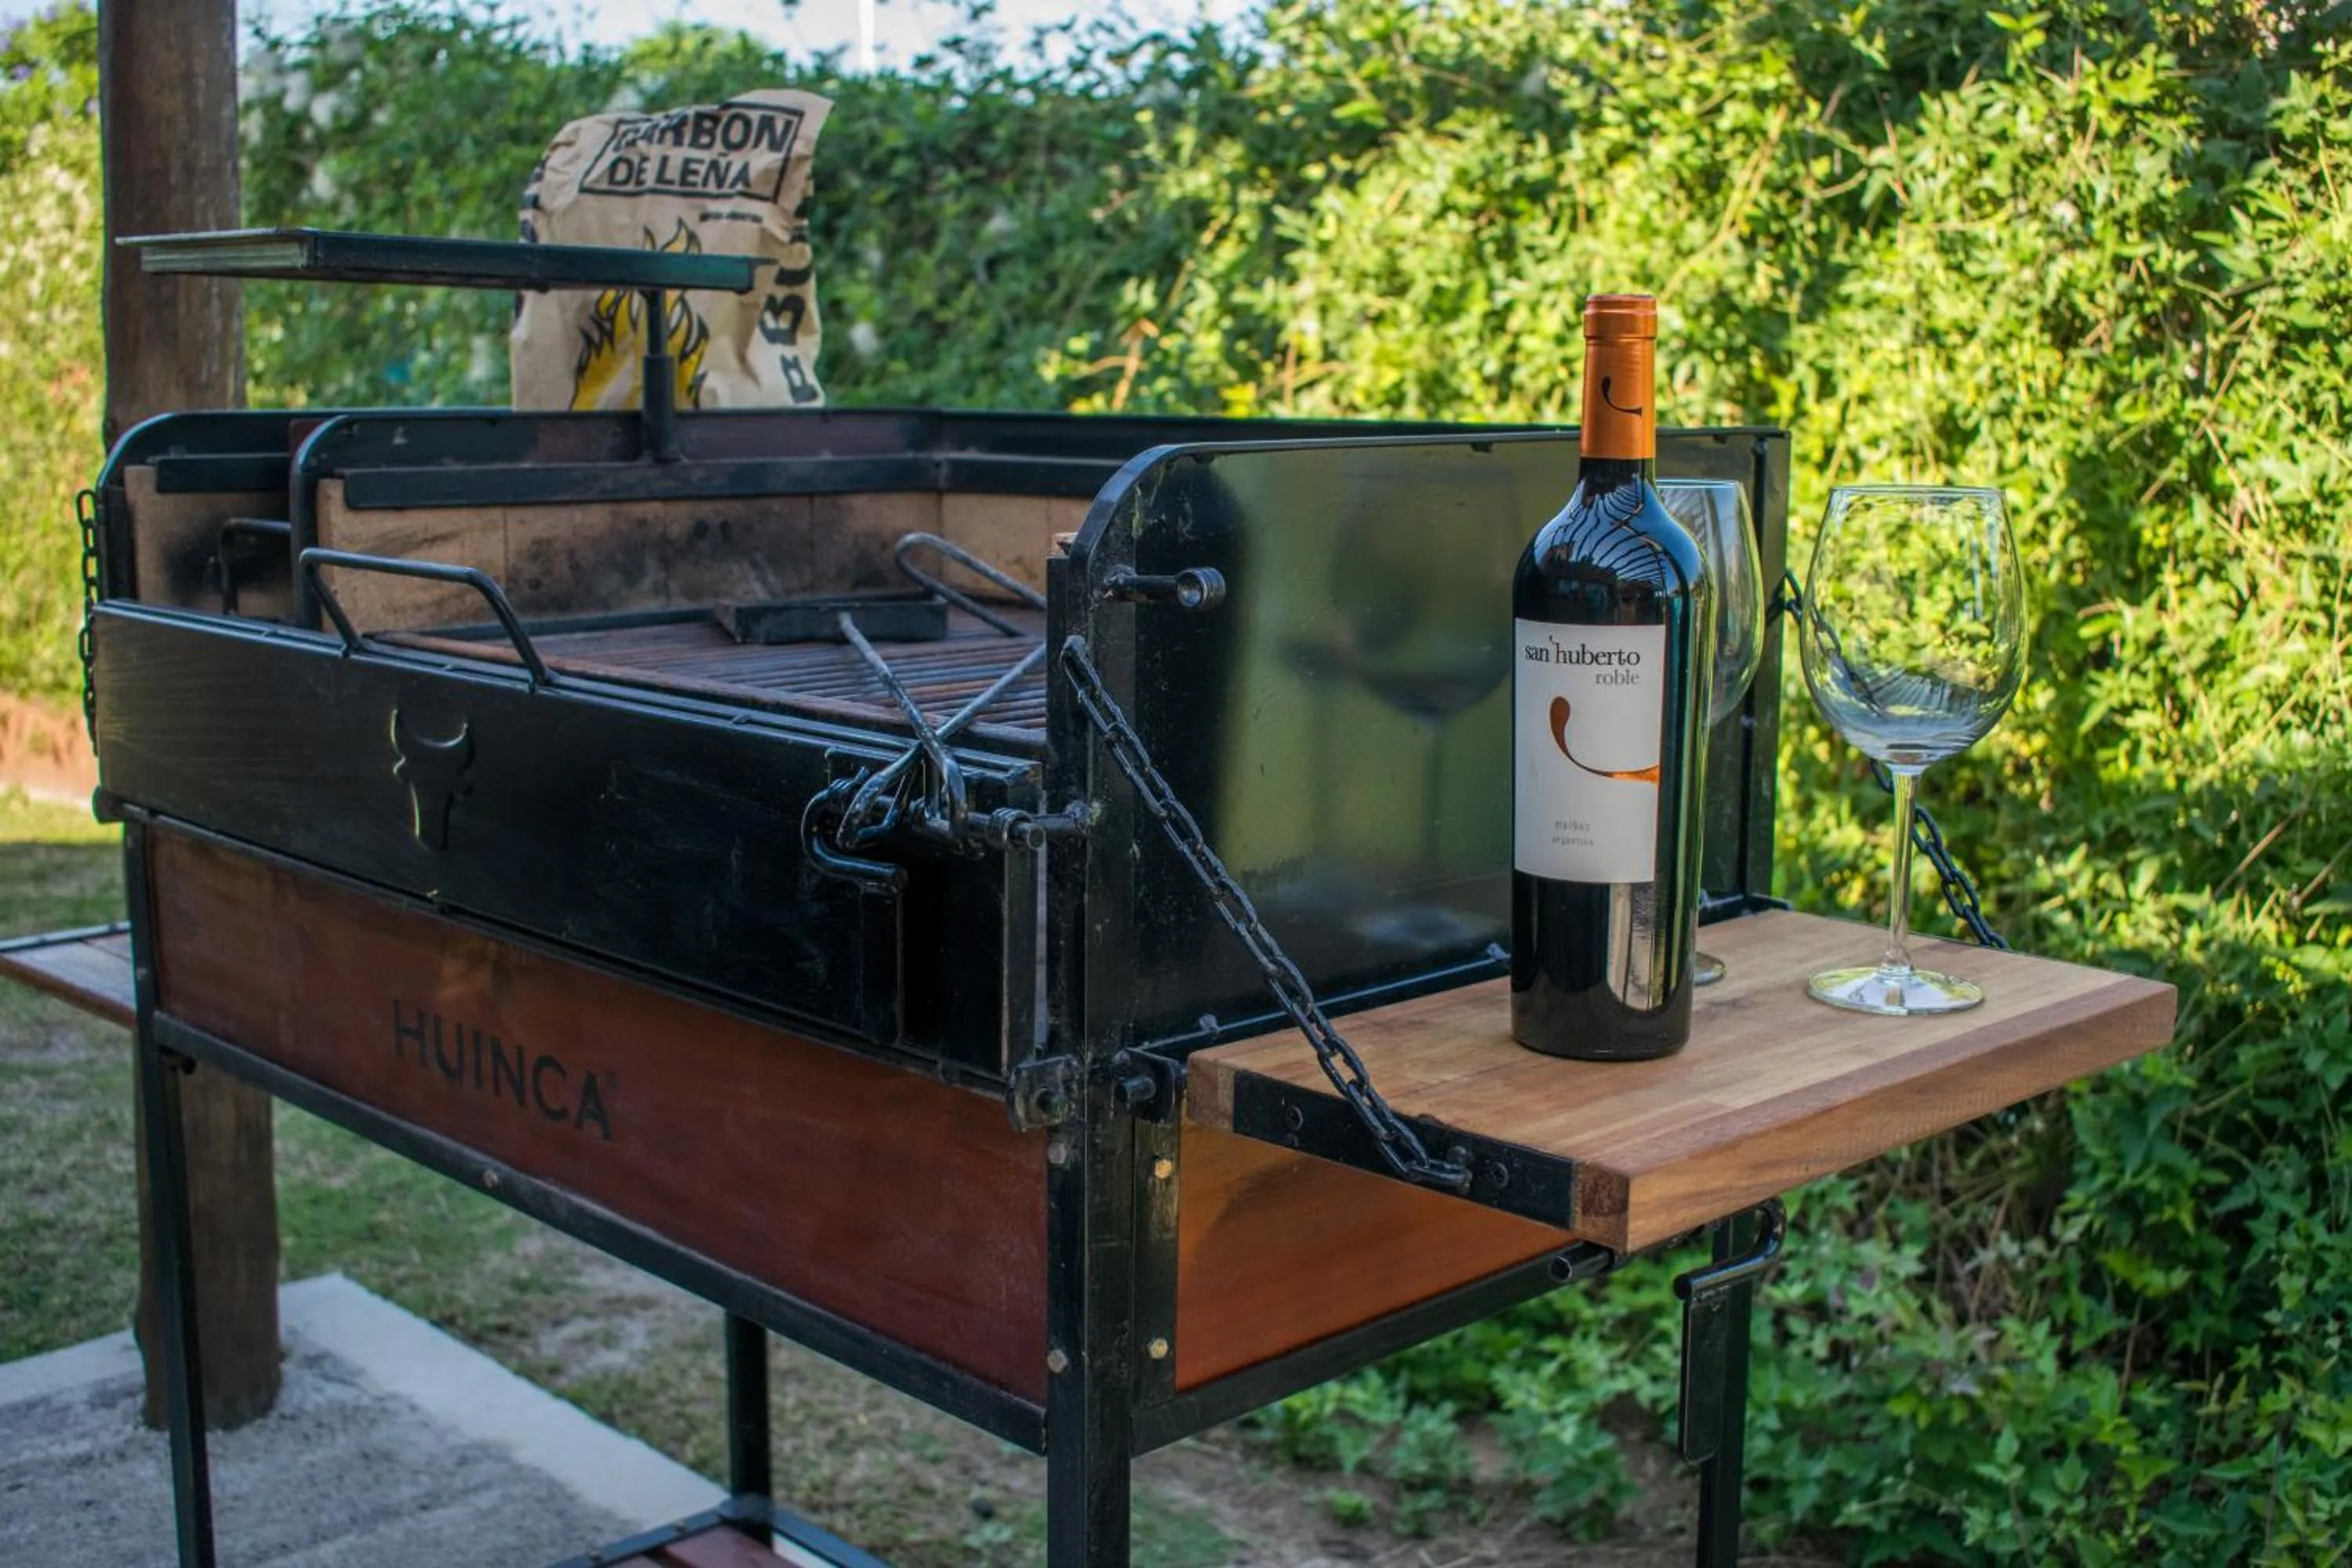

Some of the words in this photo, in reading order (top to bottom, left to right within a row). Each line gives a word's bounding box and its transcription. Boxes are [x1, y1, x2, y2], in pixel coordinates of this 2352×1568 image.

[608, 155, 649, 187] DE
[655, 152, 751, 190] LEÑA
[1555, 643, 1641, 666] huberto
[1595, 669, 1640, 686] roble
[394, 1000, 612, 1140] HUINCA
